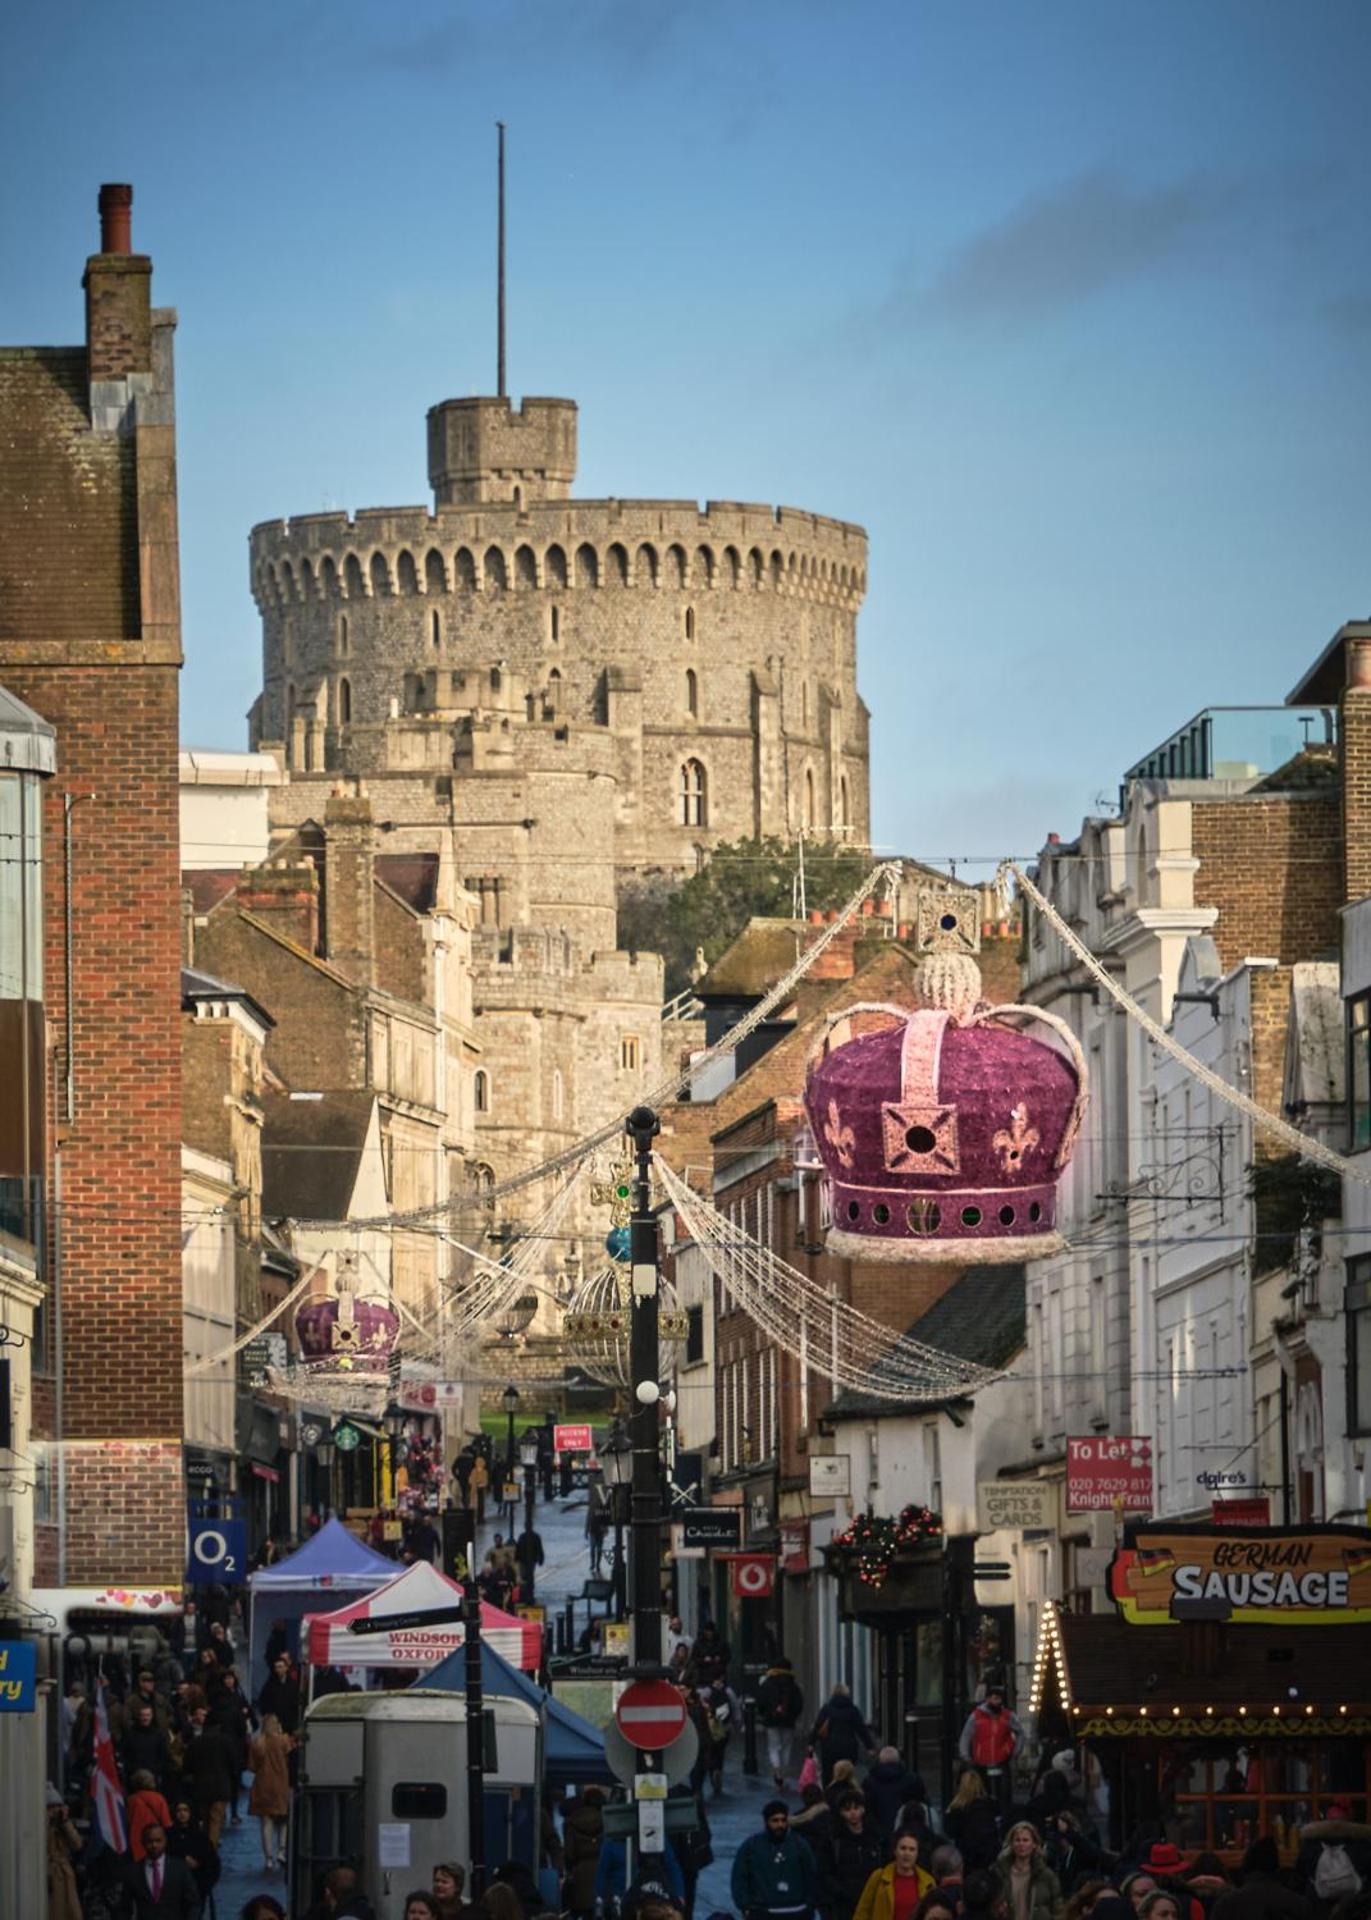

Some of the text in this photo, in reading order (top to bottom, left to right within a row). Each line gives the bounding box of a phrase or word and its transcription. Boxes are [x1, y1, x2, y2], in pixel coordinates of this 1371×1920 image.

[1070, 1441, 1127, 1460] To Let
[1069, 1478, 1093, 1490] 020
[1096, 1478, 1128, 1490] 7629
[1196, 1470, 1247, 1486] claire's
[984, 1486, 1046, 1496] TEMPTATION
[986, 1497, 1043, 1512] GIFTS &
[1069, 1491, 1153, 1509] Knight Fran
[989, 1511, 1042, 1526] CARDS
[1213, 1542, 1315, 1570] GERMAN
[1173, 1565, 1350, 1606] SAUSAGE
[388, 1632, 463, 1644] WINDSOR
[392, 1648, 451, 1660] OXFOR
